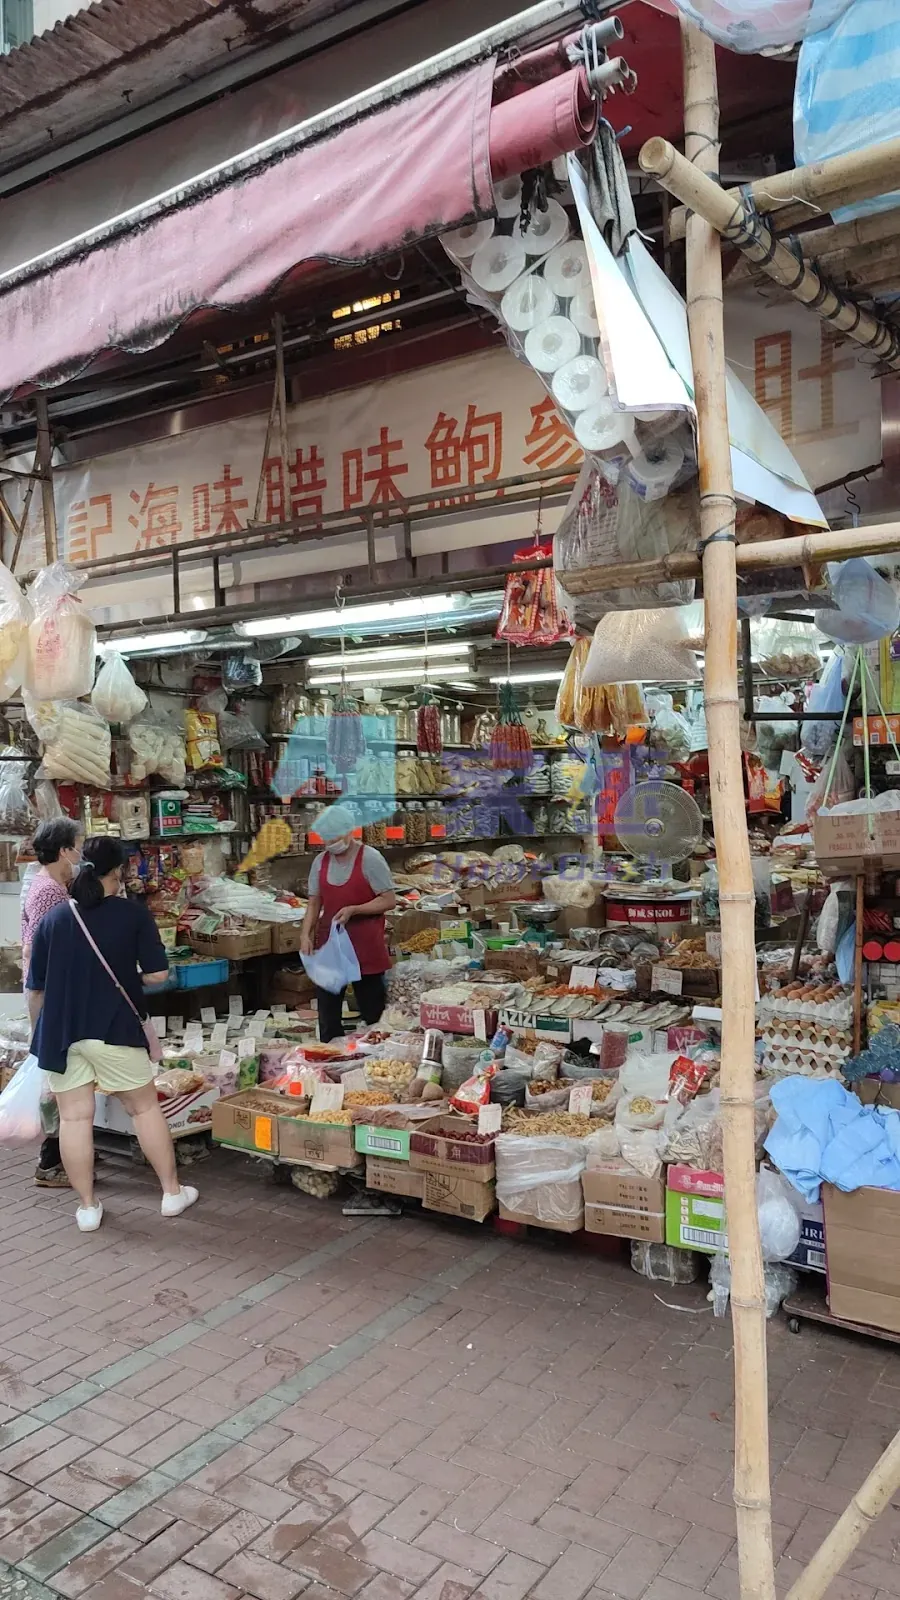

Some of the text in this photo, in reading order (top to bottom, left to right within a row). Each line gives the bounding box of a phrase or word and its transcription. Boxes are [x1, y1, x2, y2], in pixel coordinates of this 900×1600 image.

[647, 908, 675, 918] SKOL
[425, 1005, 475, 1023] vita vit
[498, 1009, 536, 1029] AZIZI
[801, 1226, 824, 1241] IRL
